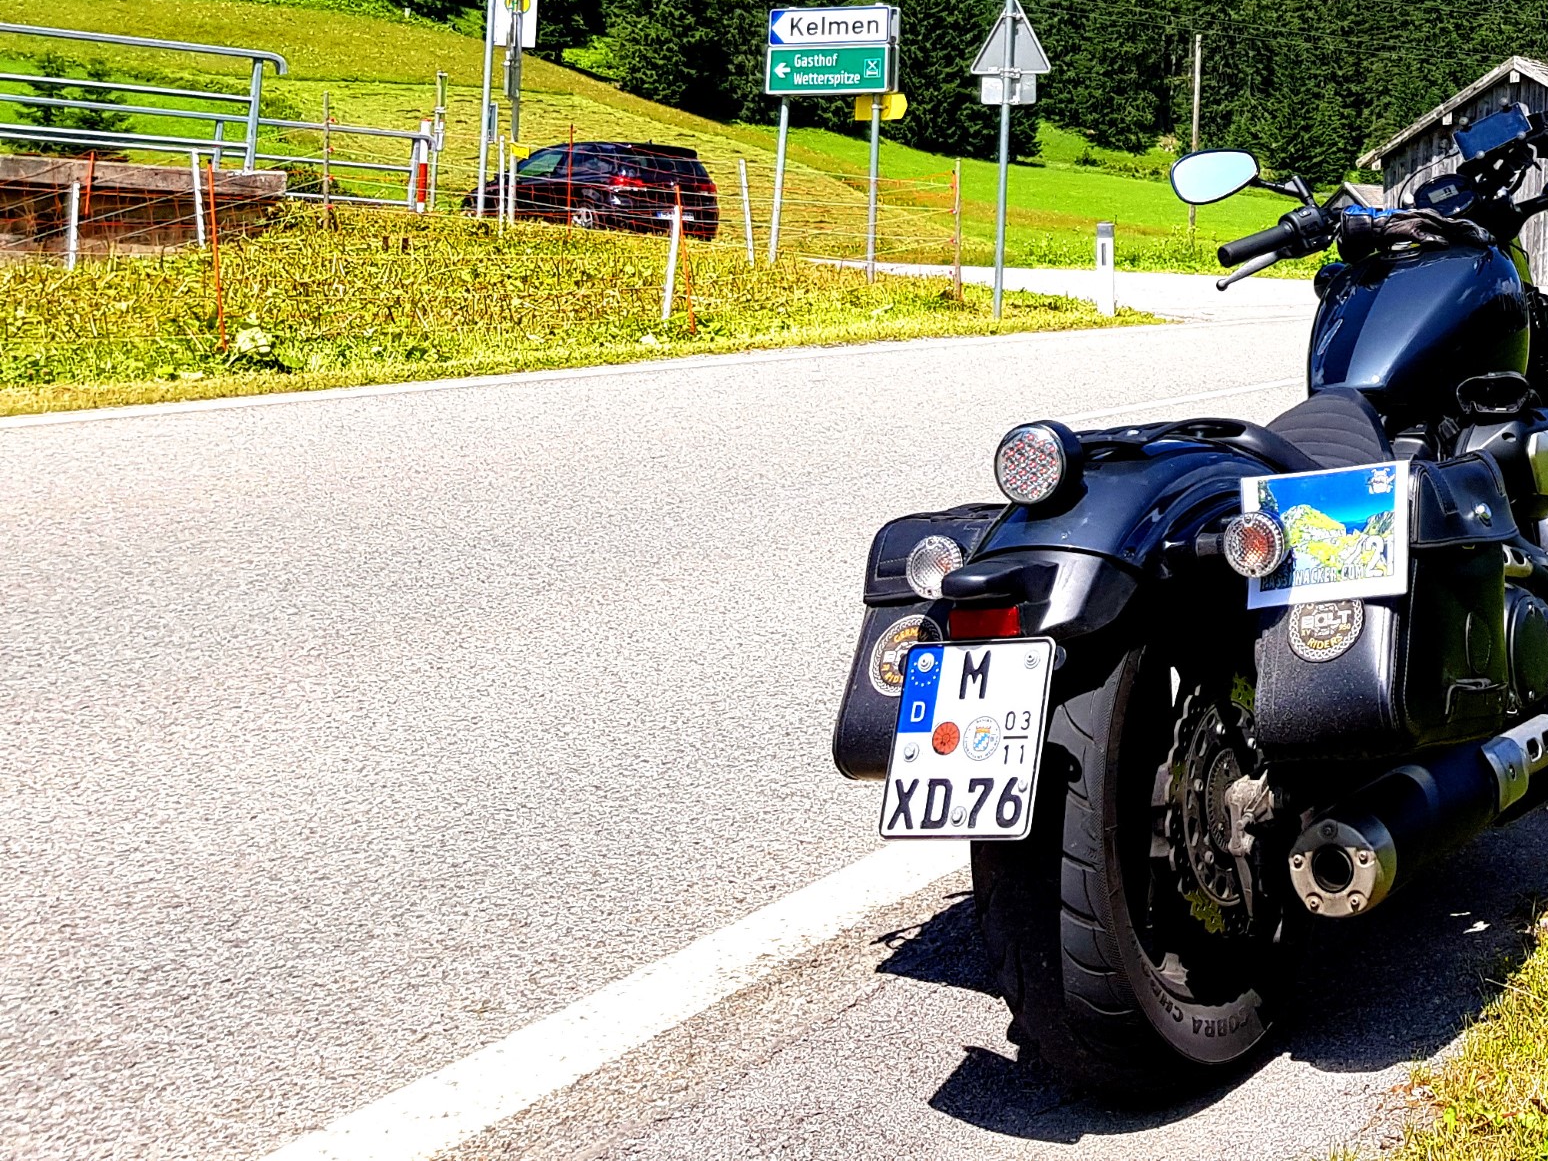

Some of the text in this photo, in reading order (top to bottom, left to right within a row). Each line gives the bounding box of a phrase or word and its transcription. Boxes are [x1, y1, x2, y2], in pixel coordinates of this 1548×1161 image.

[790, 16, 879, 37] Kelmen
[794, 53, 838, 68] Gasthof
[793, 70, 861, 87] Wetterspitze
[1301, 610, 1352, 629] BOLT
[1307, 633, 1343, 649] RIDERS
[958, 650, 991, 700] M
[910, 701, 926, 723] D
[1005, 711, 1031, 731] 03
[1003, 744, 1025, 765] 11
[1191, 1006, 1250, 1038] COBRA
